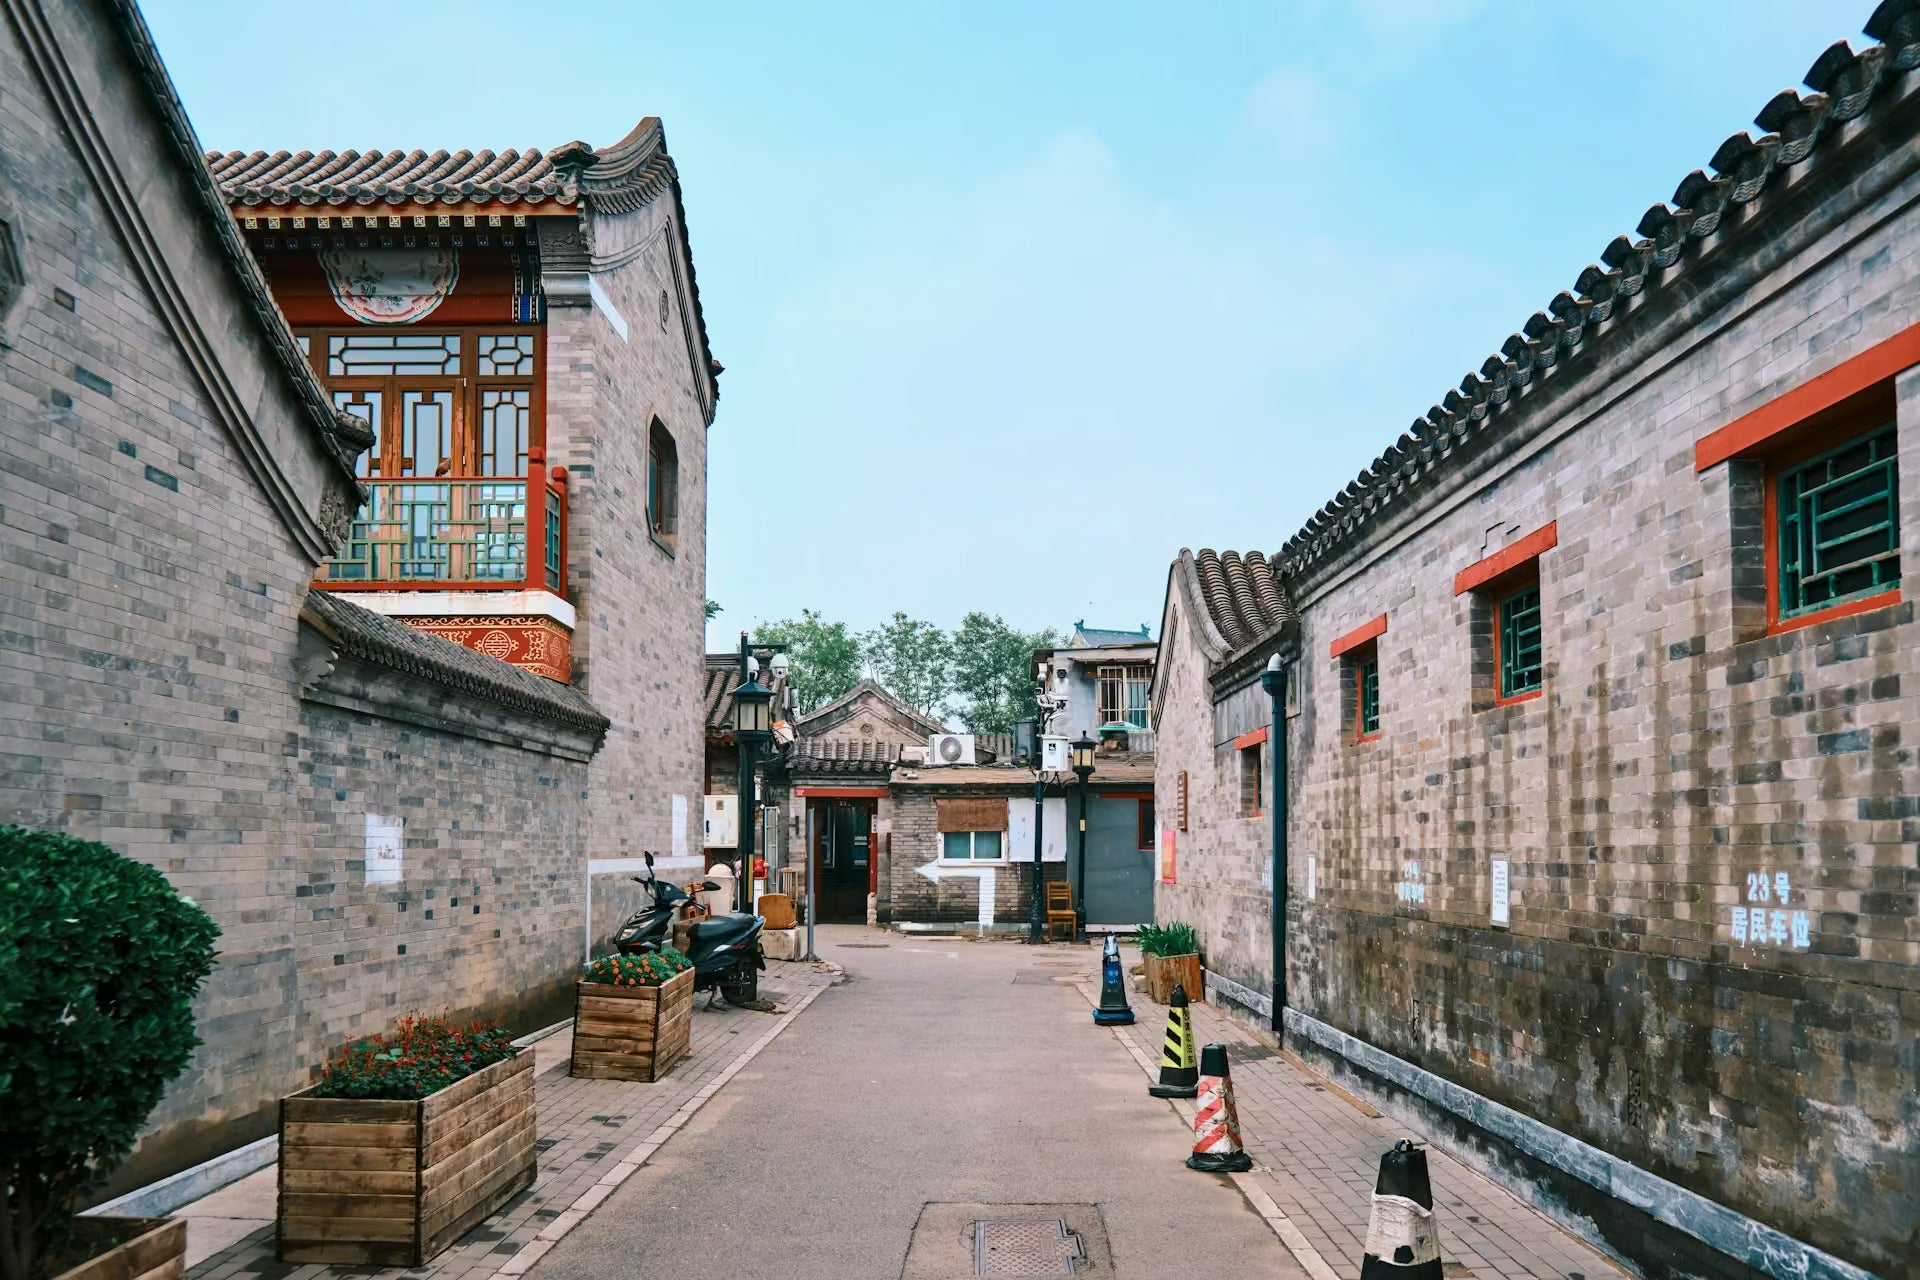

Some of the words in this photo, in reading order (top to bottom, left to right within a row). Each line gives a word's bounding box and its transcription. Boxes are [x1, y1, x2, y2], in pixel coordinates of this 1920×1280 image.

[1747, 872, 1791, 904] 23号
[1731, 907, 1810, 947] 居民车位
